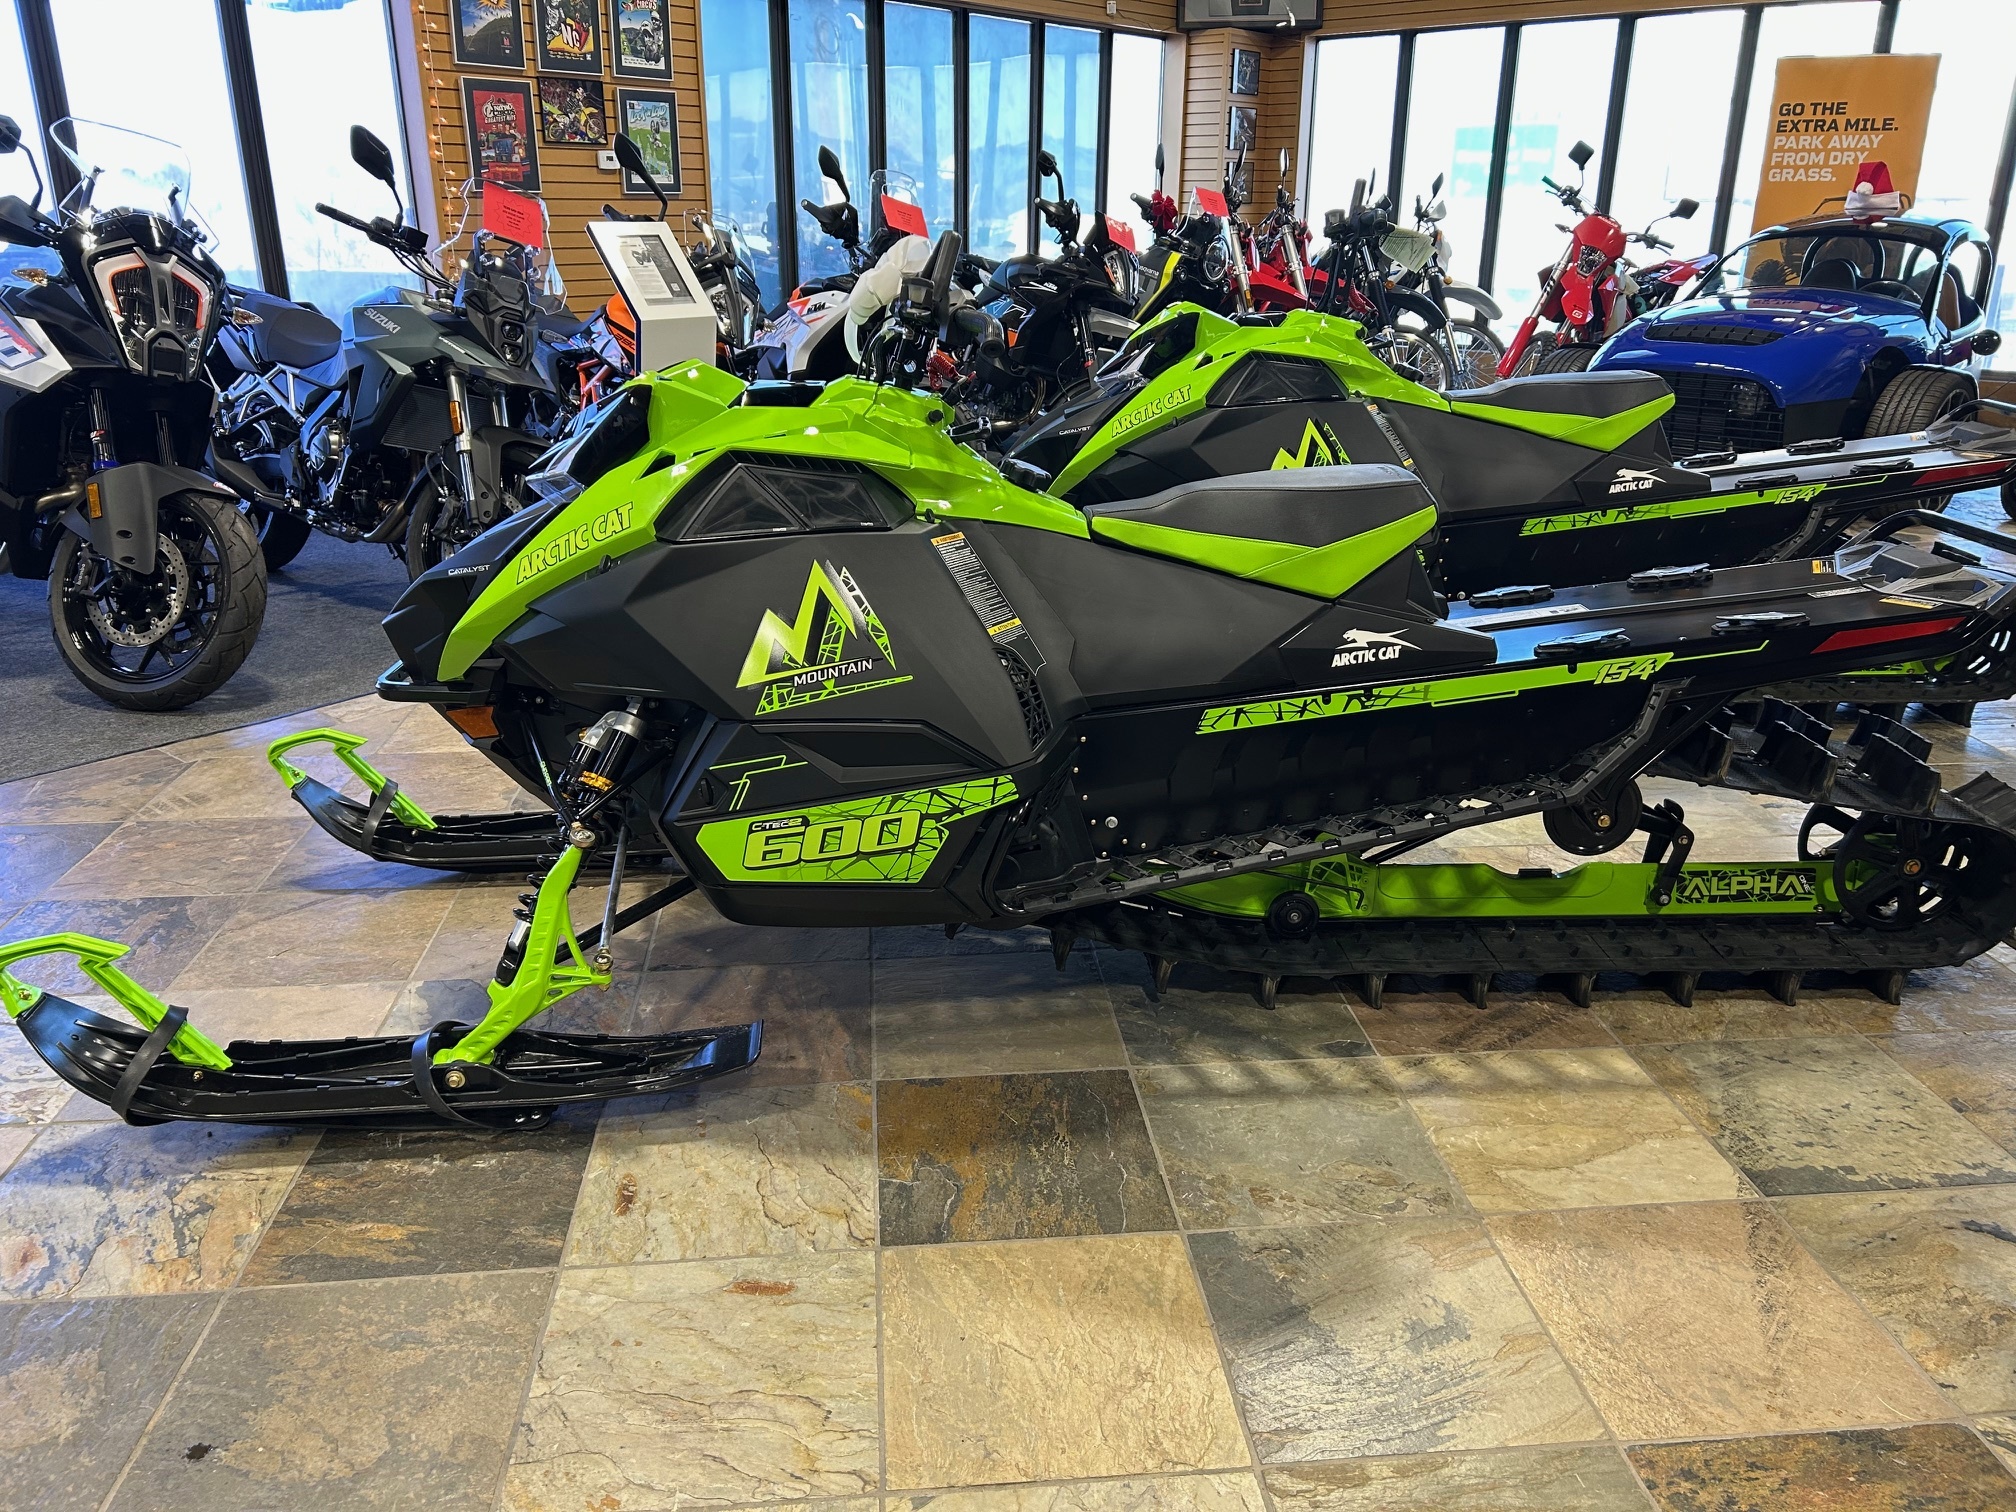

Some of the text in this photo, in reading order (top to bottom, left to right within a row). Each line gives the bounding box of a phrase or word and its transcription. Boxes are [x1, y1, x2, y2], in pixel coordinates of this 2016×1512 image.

[1779, 101, 1848, 116] GO THE
[1776, 117, 1899, 133] EXTRA MILE.
[1773, 134, 1884, 149] PARK AWAY
[1771, 151, 1869, 166] FROM DRY
[1768, 168, 1837, 182] GRASS.
[807, 302, 826, 314] KTM
[363, 307, 401, 334] SUZUKI
[1112, 384, 1191, 438] ARCTIC CAT
[1058, 425, 1092, 436] CATALYST
[1608, 479, 1655, 494] ARCTIC CAT
[1774, 486, 1816, 505] 154
[517, 502, 634, 585] ARCTIC CAT
[448, 564, 491, 577] CATALYST
[1331, 645, 1402, 668] ARCTIC CAT
[793, 658, 874, 687] MOUNTAIN
[1593, 658, 1656, 685] 154
[743, 809, 922, 871] 600
[1683, 874, 1811, 899] ALPHA ONE
